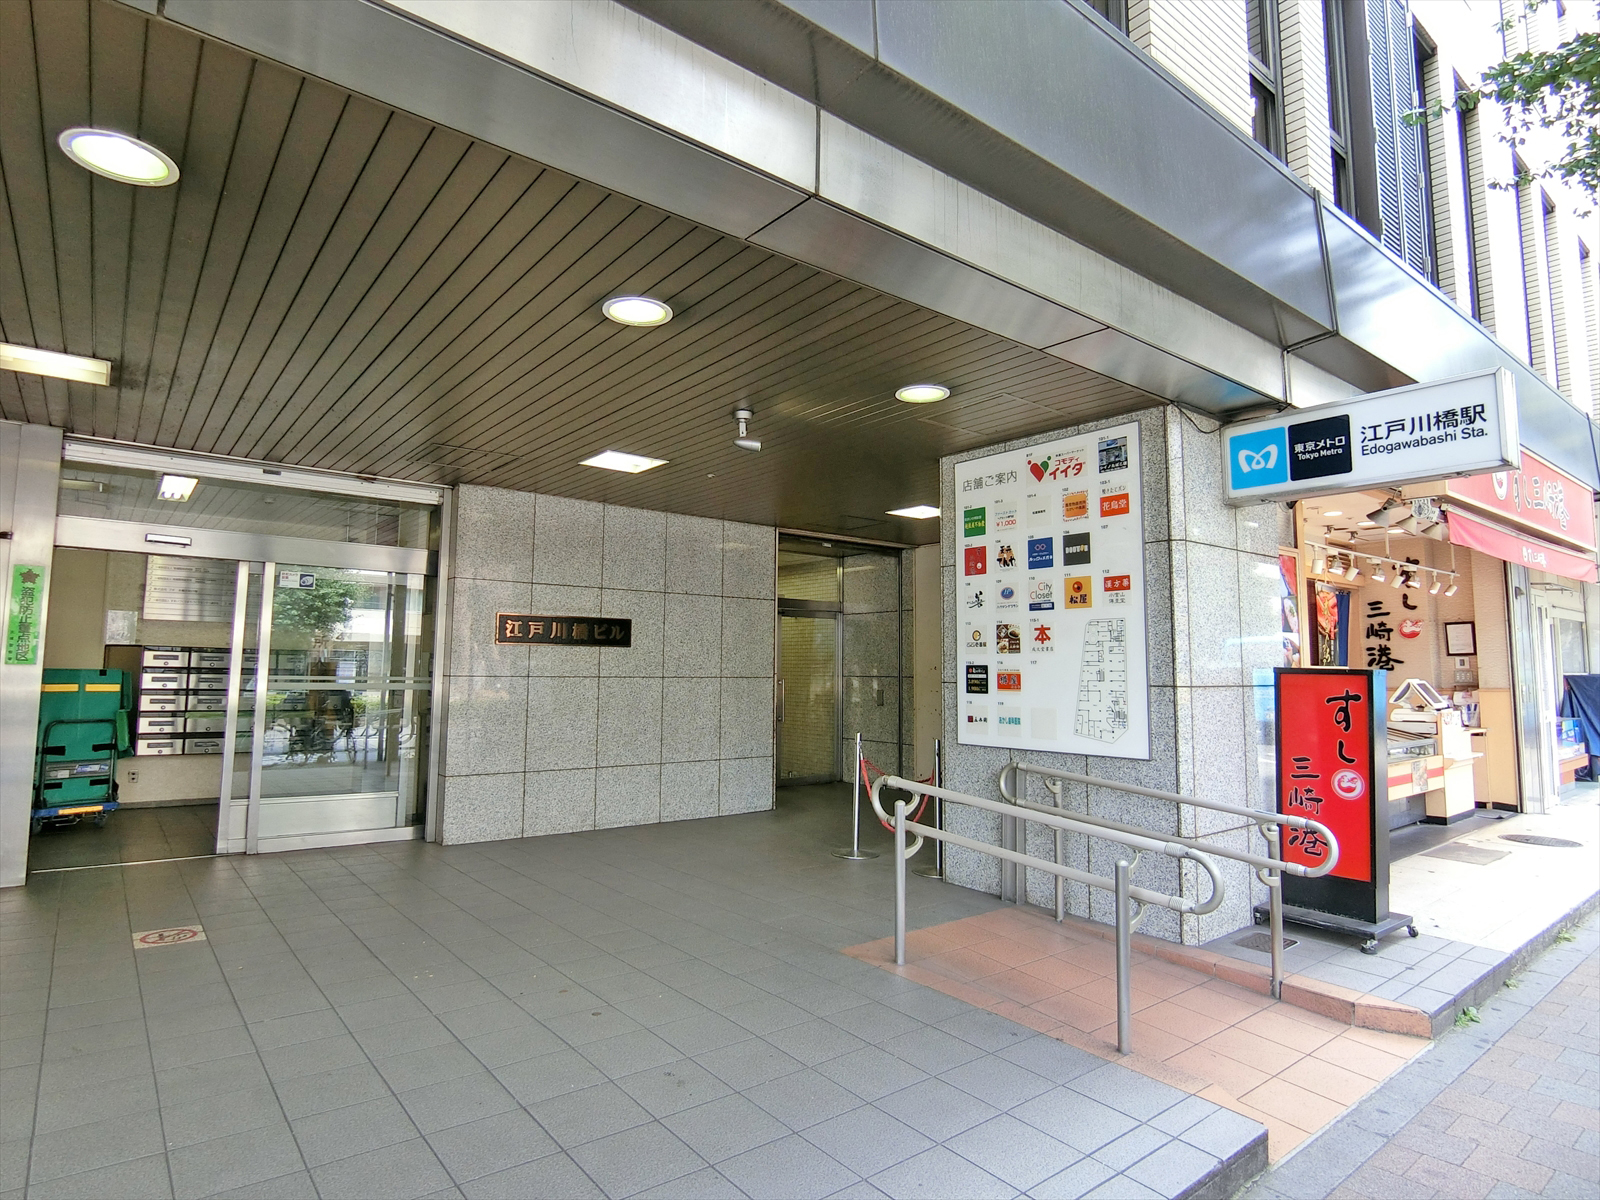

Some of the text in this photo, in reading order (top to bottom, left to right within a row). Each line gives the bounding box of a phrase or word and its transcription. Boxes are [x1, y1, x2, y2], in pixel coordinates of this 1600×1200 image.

[1360, 403, 1487, 444] 江戸川橋駅
[1294, 435, 1346, 454] 東京メトロ
[1361, 426, 1489, 457] Edogawabashi Sta.
[1055, 456, 1080, 467] コモディ
[1297, 447, 1343, 461] Tokyo Metro
[962, 470, 1017, 493] 店舗ご案内
[1030, 591, 1053, 600] Closet
[1037, 581, 1052, 592] City
[1069, 593, 1088, 604] 松屋
[505, 619, 625, 640] 江戸川橋ビル
[1034, 624, 1051, 645] 本
[1366, 600, 1405, 671] 三崎港
[1325, 689, 1363, 764] すし
[1288, 756, 1329, 857] 三崎港
